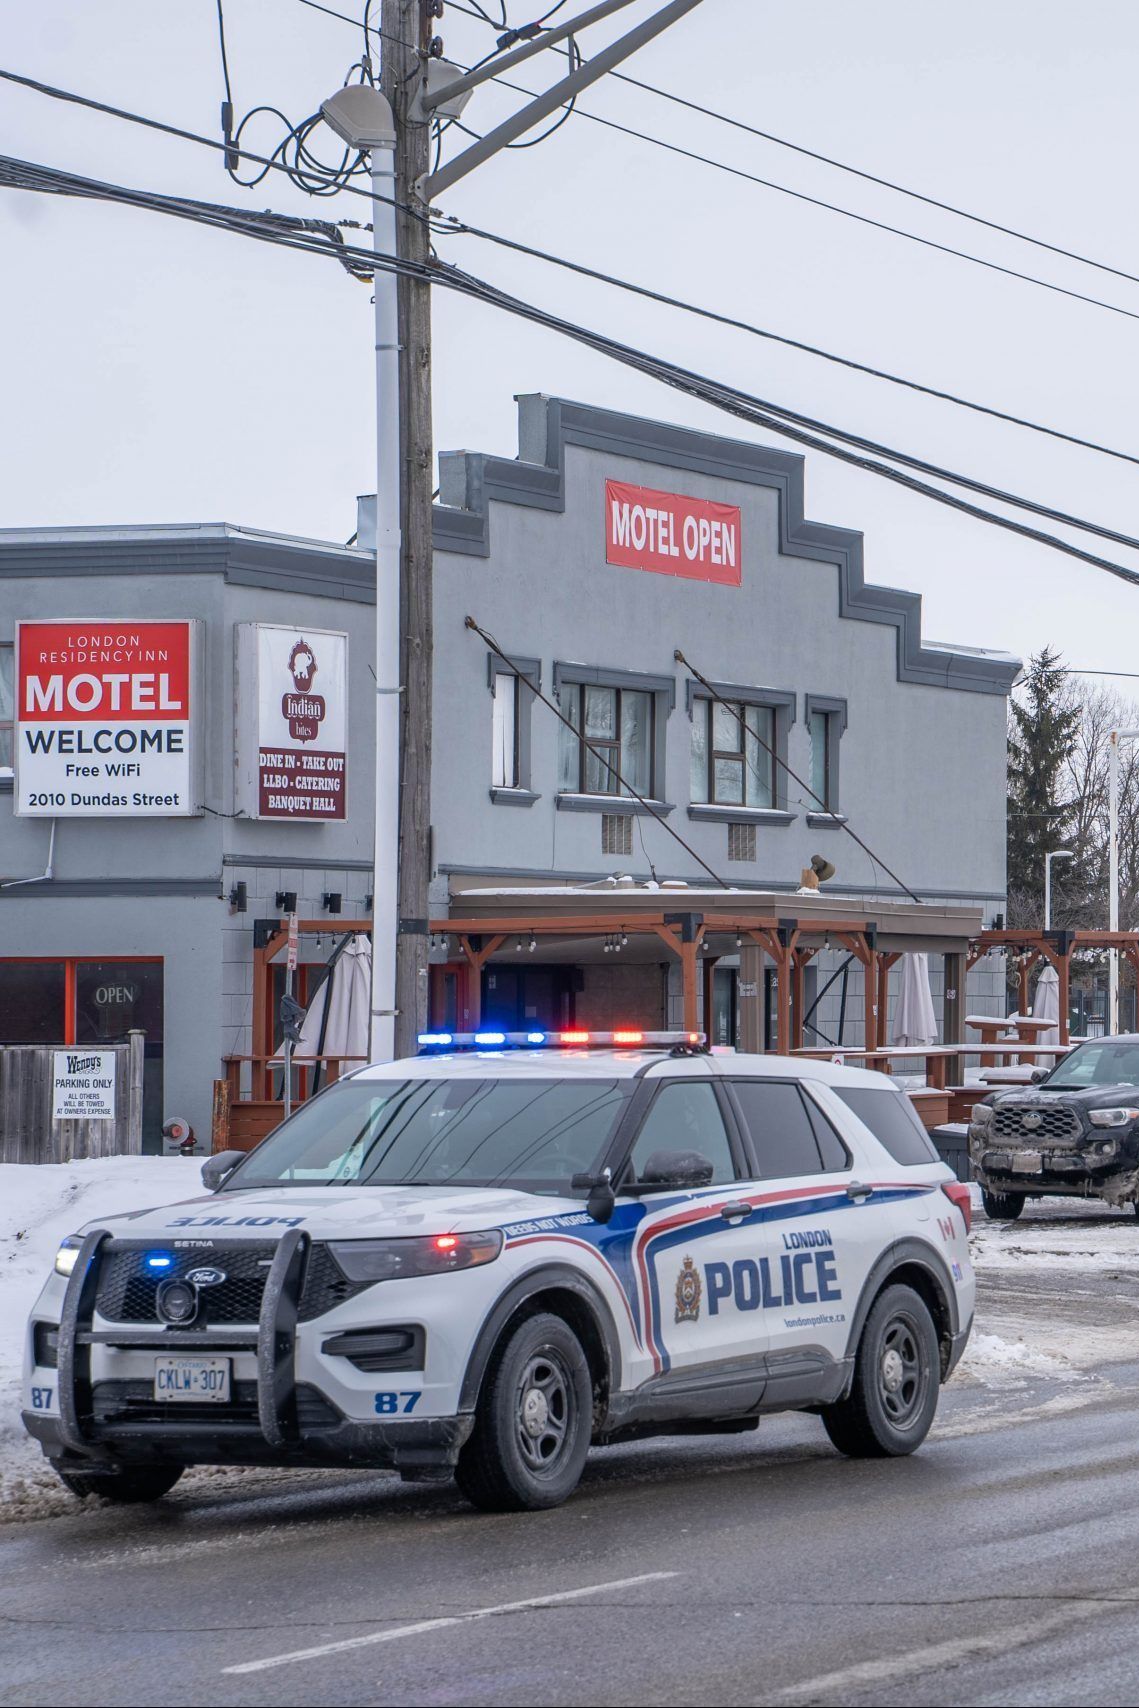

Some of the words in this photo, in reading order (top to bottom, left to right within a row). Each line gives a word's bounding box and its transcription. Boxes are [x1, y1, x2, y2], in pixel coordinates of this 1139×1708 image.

[612, 500, 679, 557] MOTEL
[683, 515, 736, 567] OPEN
[68, 635, 139, 648] LONDON
[40, 650, 133, 663] RESIDENCY
[139, 650, 168, 661] INN
[25, 673, 182, 712] MOTEL
[286, 696, 321, 718] Indian
[296, 722, 312, 736] bites
[25, 729, 184, 754] WELCOME
[65, 764, 100, 777] Free
[105, 763, 141, 777] WiFi
[259, 753, 284, 767] DINE
[284, 755, 296, 768] IN
[301, 756, 326, 770] TAKE
[326, 758, 344, 771] OUT
[263, 774, 288, 788] LLBO
[295, 777, 341, 791] CATERING
[28, 793, 66, 806] 2010
[71, 793, 130, 806] Dundas
[133, 792, 180, 806] Street
[268, 795, 312, 812] BANQUET
[312, 797, 336, 811] HALL
[96, 986, 134, 1003] OPEN
[55, 1079, 90, 1088] PARKING
[92, 1079, 113, 1088] ONLY
[534, 1218, 559, 1230] NOT
[173, 1240, 214, 1248] SETINA
[782, 1229, 833, 1250] LONDON
[704, 1250, 842, 1315] POLICE
[784, 1313, 846, 1328] londonpolice.ca
[31, 1387, 53, 1409] 87
[374, 1391, 423, 1414] 87
